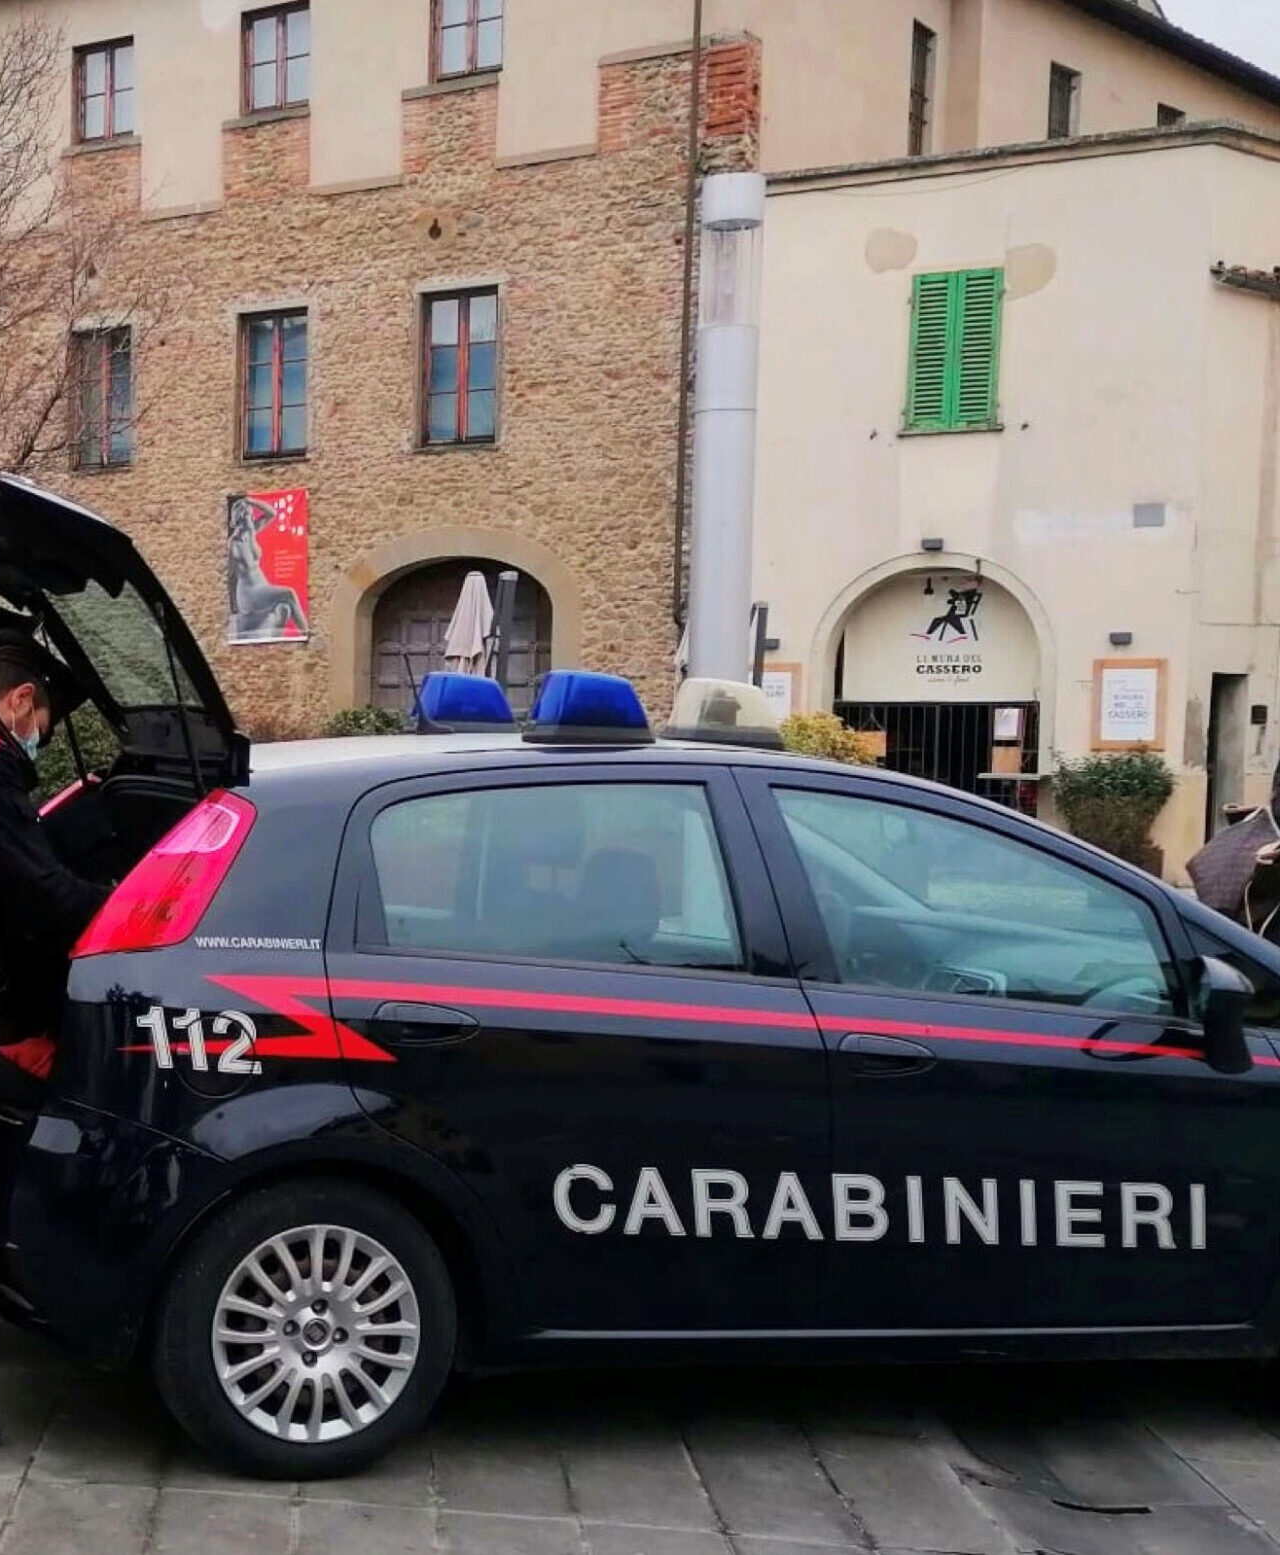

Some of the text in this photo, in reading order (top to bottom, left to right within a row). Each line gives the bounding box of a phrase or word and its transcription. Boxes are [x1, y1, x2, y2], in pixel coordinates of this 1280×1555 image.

[916, 664, 983, 675] CASSERO
[194, 936, 322, 950] WWW.CARABINIERI.IT
[136, 1005, 263, 1076] 112
[553, 1163, 1206, 1250] CARABINIERI
